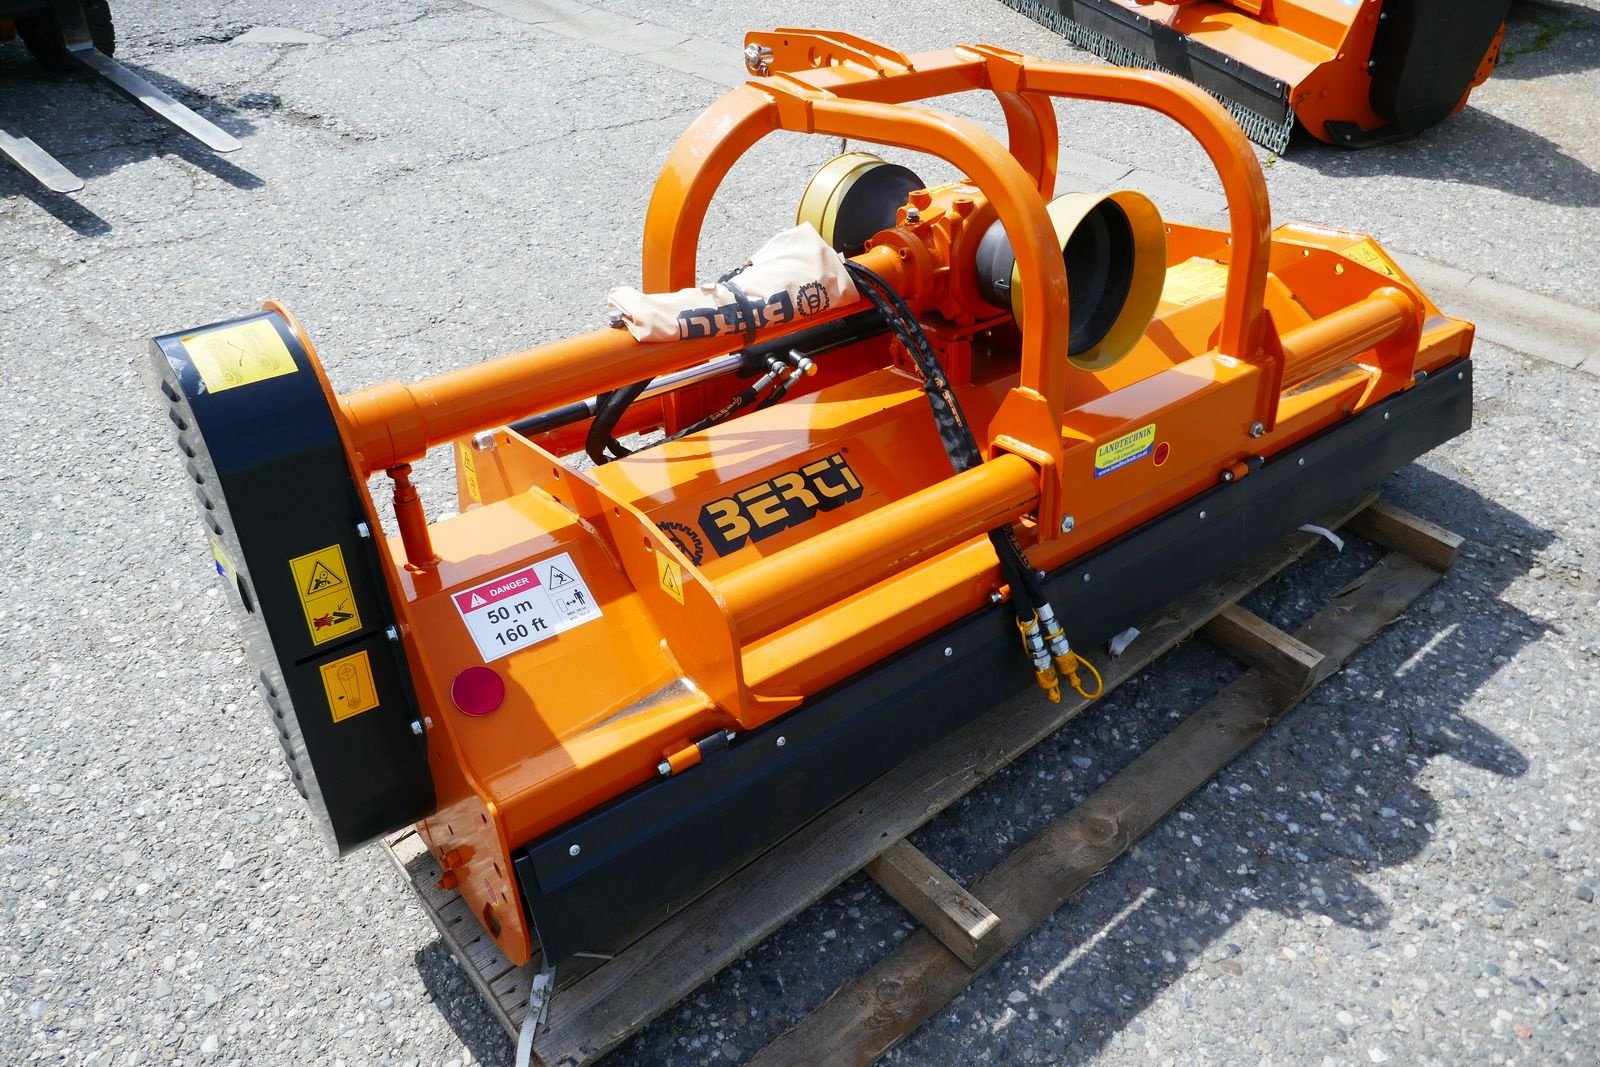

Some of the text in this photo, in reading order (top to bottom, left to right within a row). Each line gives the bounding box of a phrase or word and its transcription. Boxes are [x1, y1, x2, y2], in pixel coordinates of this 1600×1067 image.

[1099, 426, 1152, 457] LANDTECHNIK
[489, 577, 531, 597] DANGER
[487, 600, 533, 625] 50 m
[495, 617, 548, 646] 160 ft
